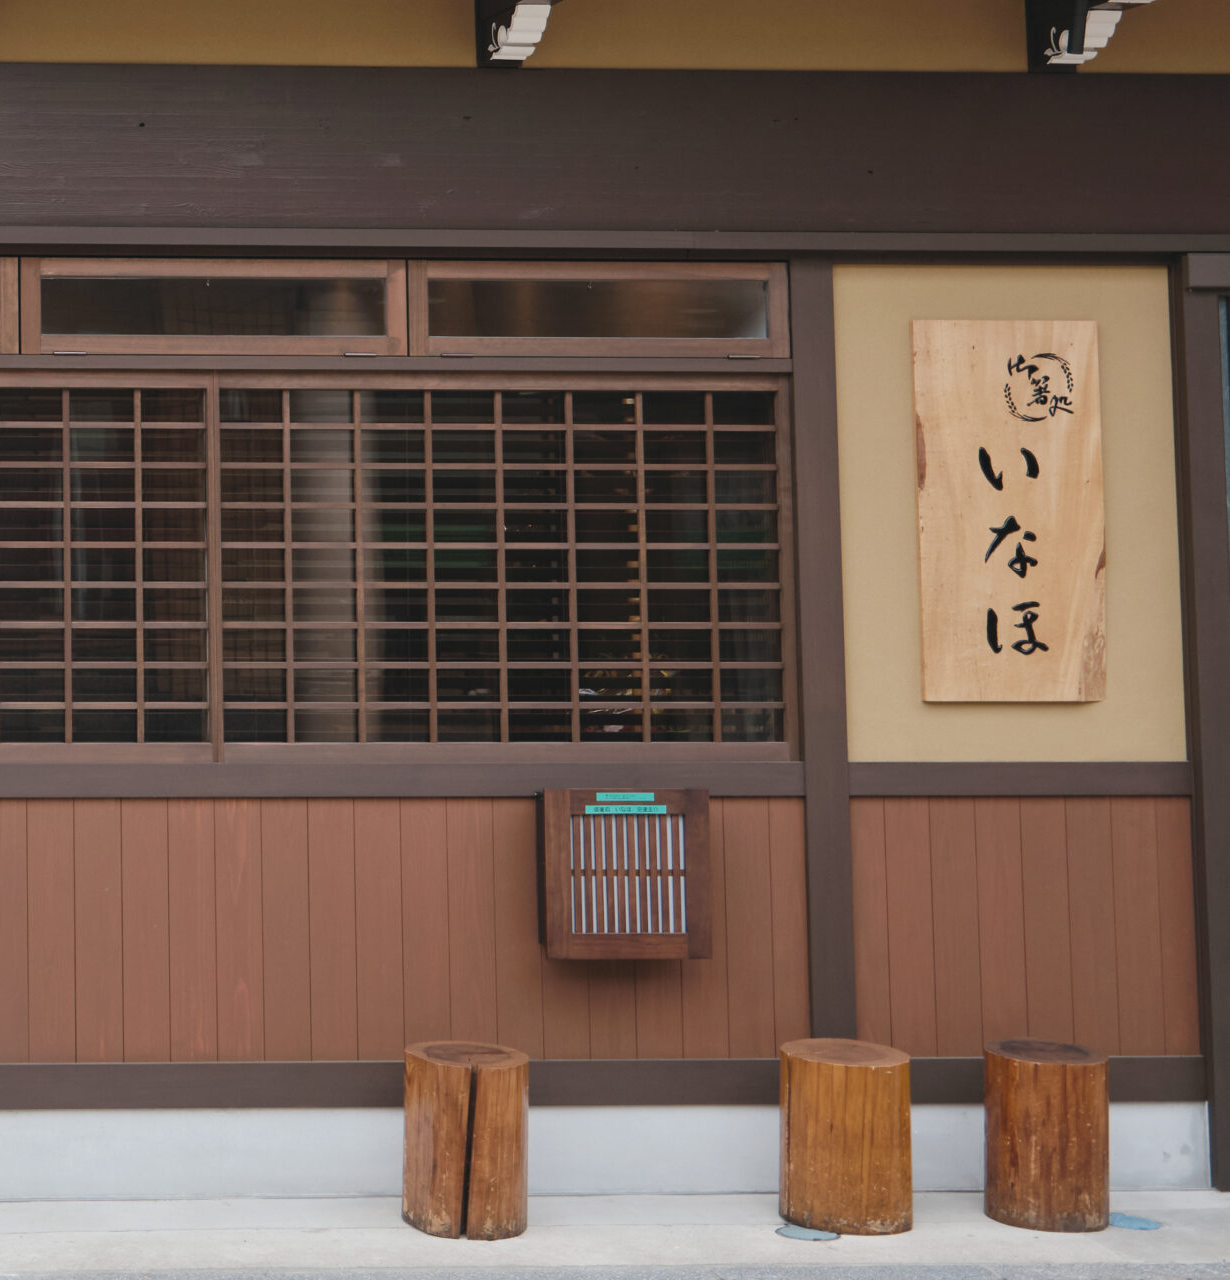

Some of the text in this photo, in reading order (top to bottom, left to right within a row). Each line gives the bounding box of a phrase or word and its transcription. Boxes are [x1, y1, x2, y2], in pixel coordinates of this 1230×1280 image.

[1006, 353, 1075, 417] 御箸処
[977, 446, 1050, 656] いなほ
